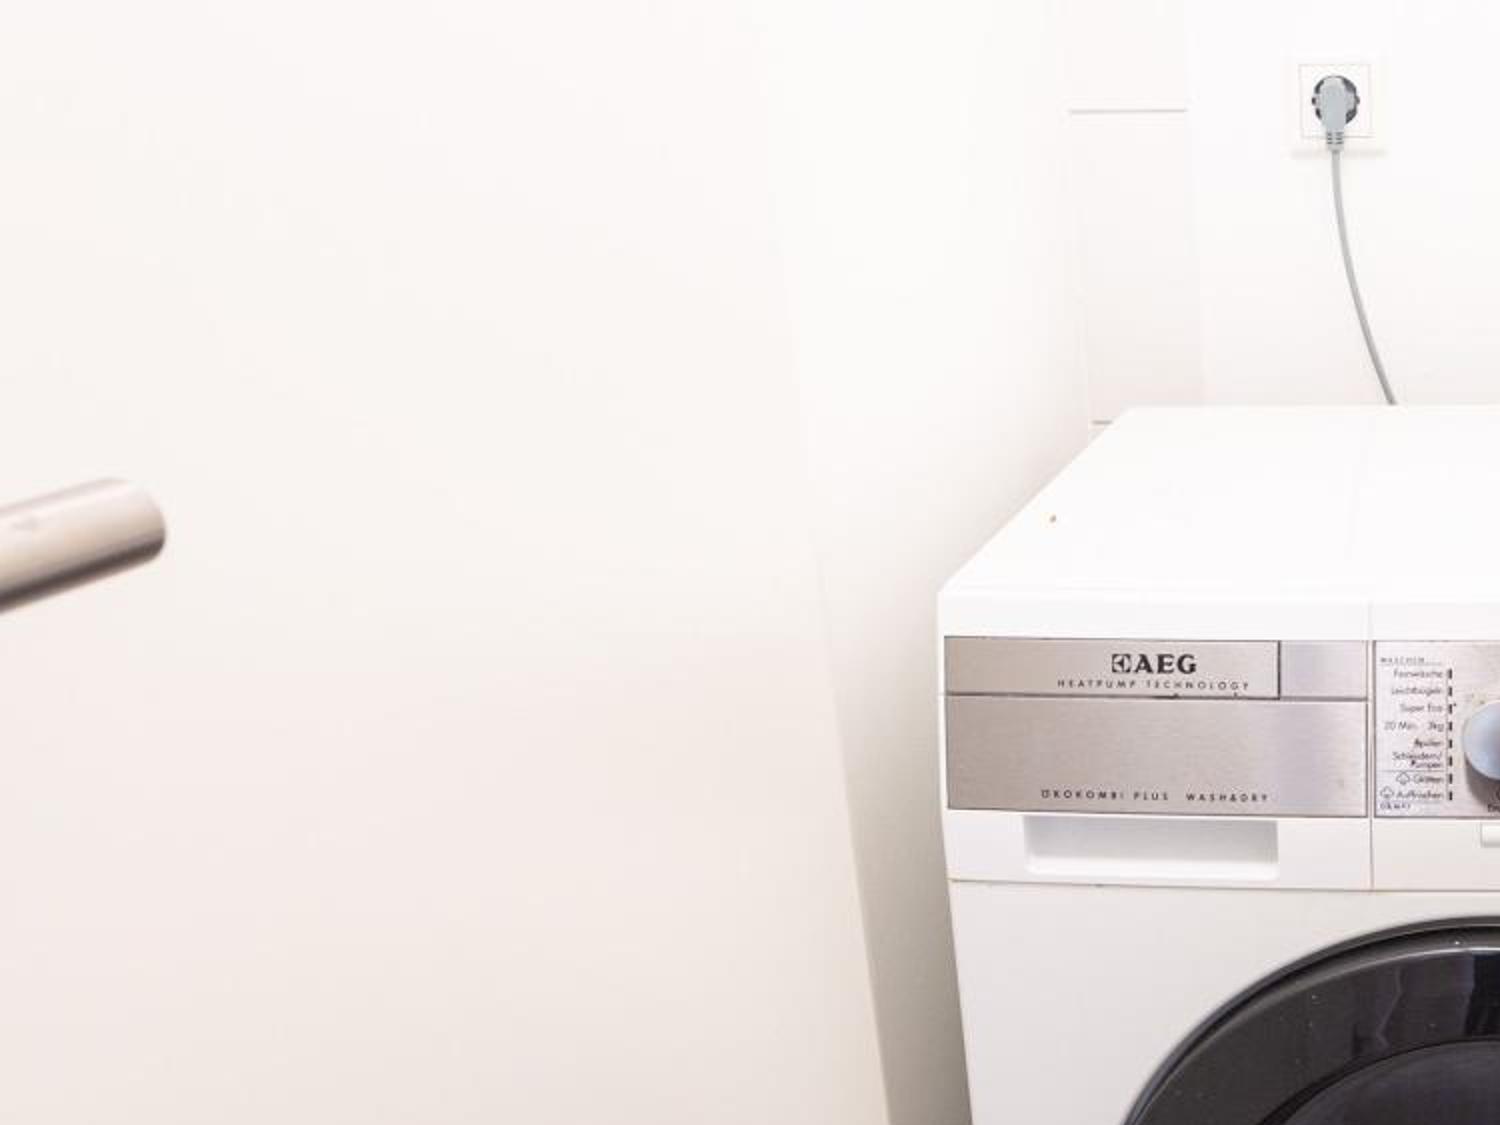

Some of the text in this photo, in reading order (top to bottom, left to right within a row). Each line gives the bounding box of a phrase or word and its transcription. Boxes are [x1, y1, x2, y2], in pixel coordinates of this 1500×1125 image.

[1135, 653, 1198, 675] AEG
[1057, 680, 1250, 691] HEATPUMP TECHNOLOGY
[1134, 790, 1169, 801] PLUS
